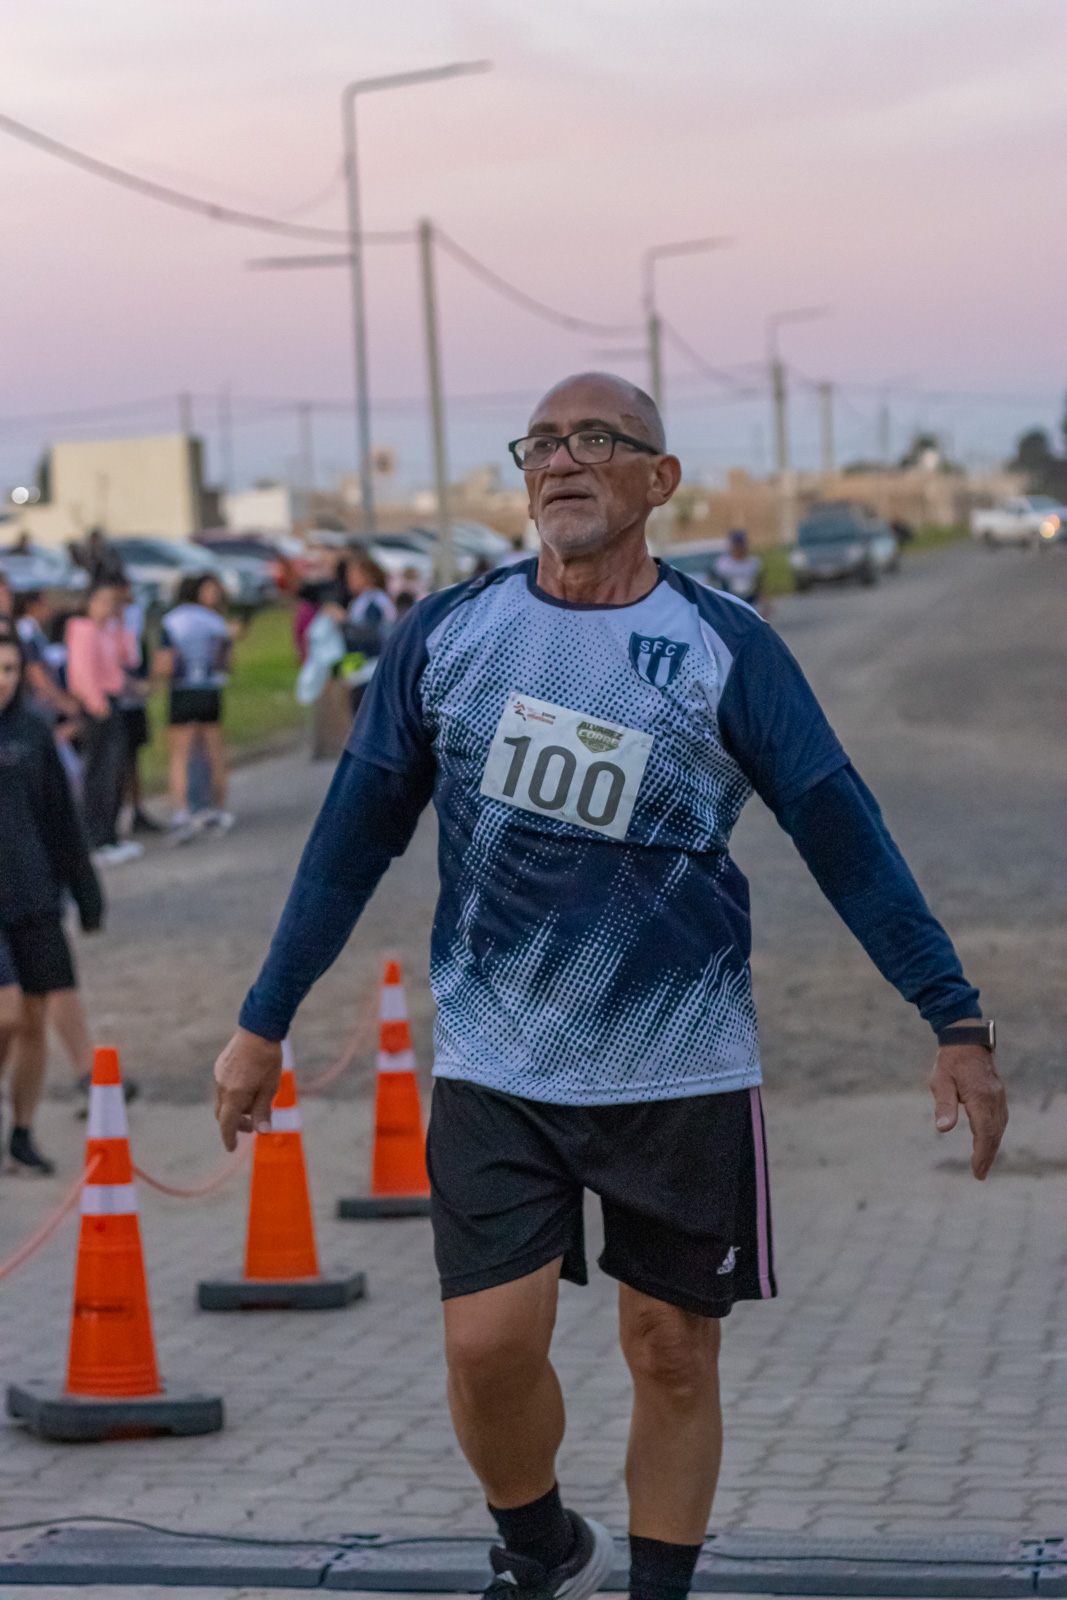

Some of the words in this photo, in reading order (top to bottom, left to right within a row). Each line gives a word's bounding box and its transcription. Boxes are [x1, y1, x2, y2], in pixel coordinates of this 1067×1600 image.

[639, 640, 677, 656] SFC
[577, 729, 619, 747] CORRE
[579, 720, 625, 740] ALVAREZ
[502, 735, 626, 826] 100
